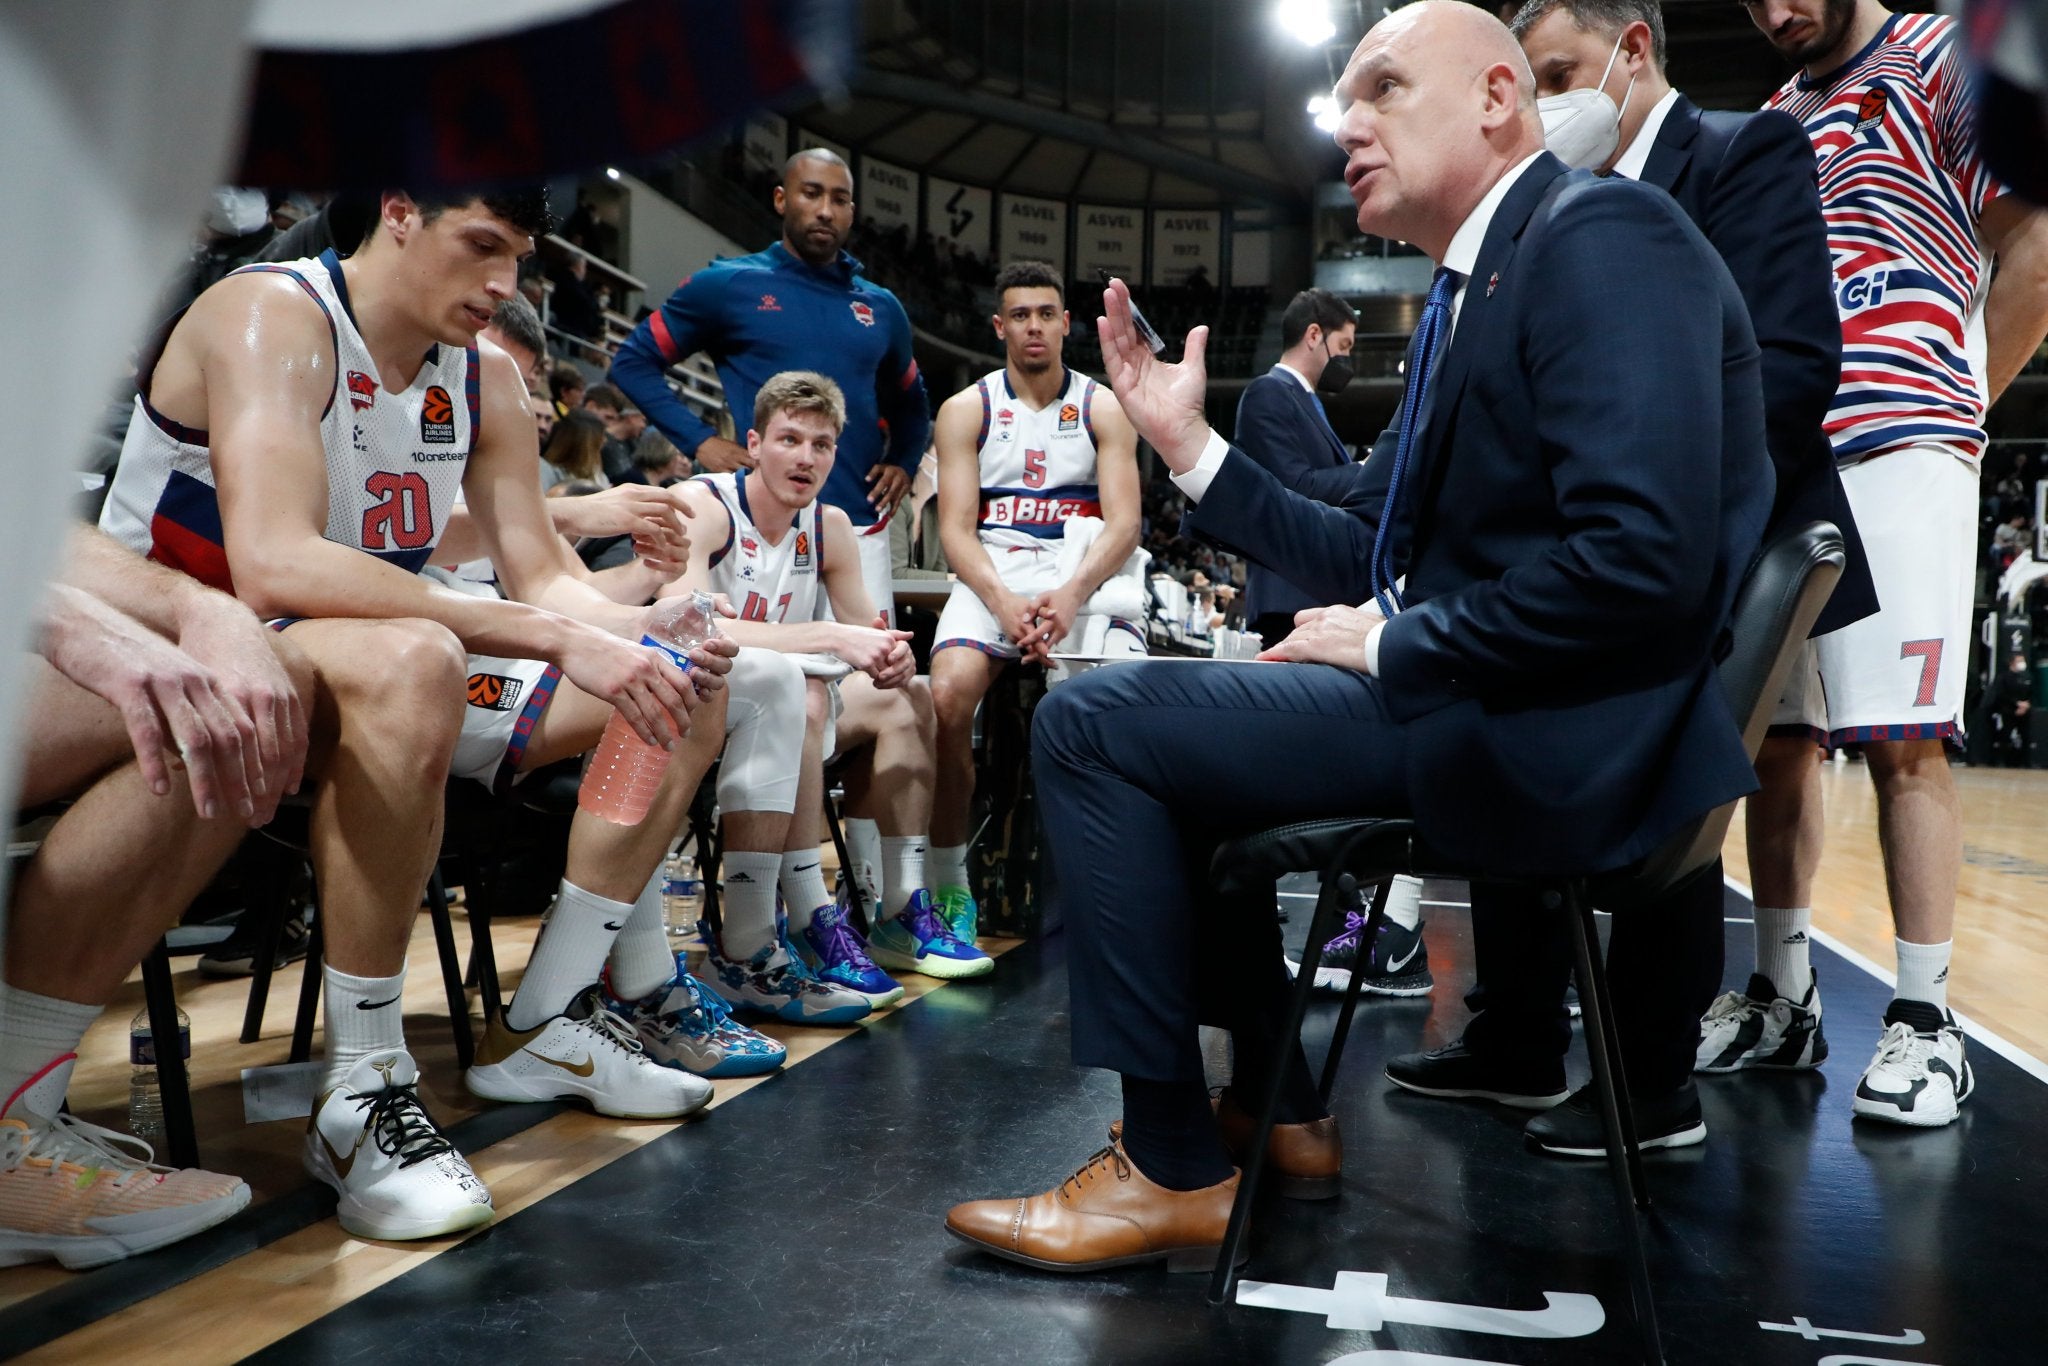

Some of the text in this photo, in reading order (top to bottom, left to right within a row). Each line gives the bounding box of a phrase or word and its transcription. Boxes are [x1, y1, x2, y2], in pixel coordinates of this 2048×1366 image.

[1010, 203, 1057, 221] ASVEL
[1087, 213, 1133, 228] ASVEL
[1163, 218, 1211, 231] ASVEL
[1023, 449, 1046, 488] 5
[361, 470, 434, 549] 20
[1900, 637, 1944, 707] 7
[498, 680, 511, 708] TURKISH
